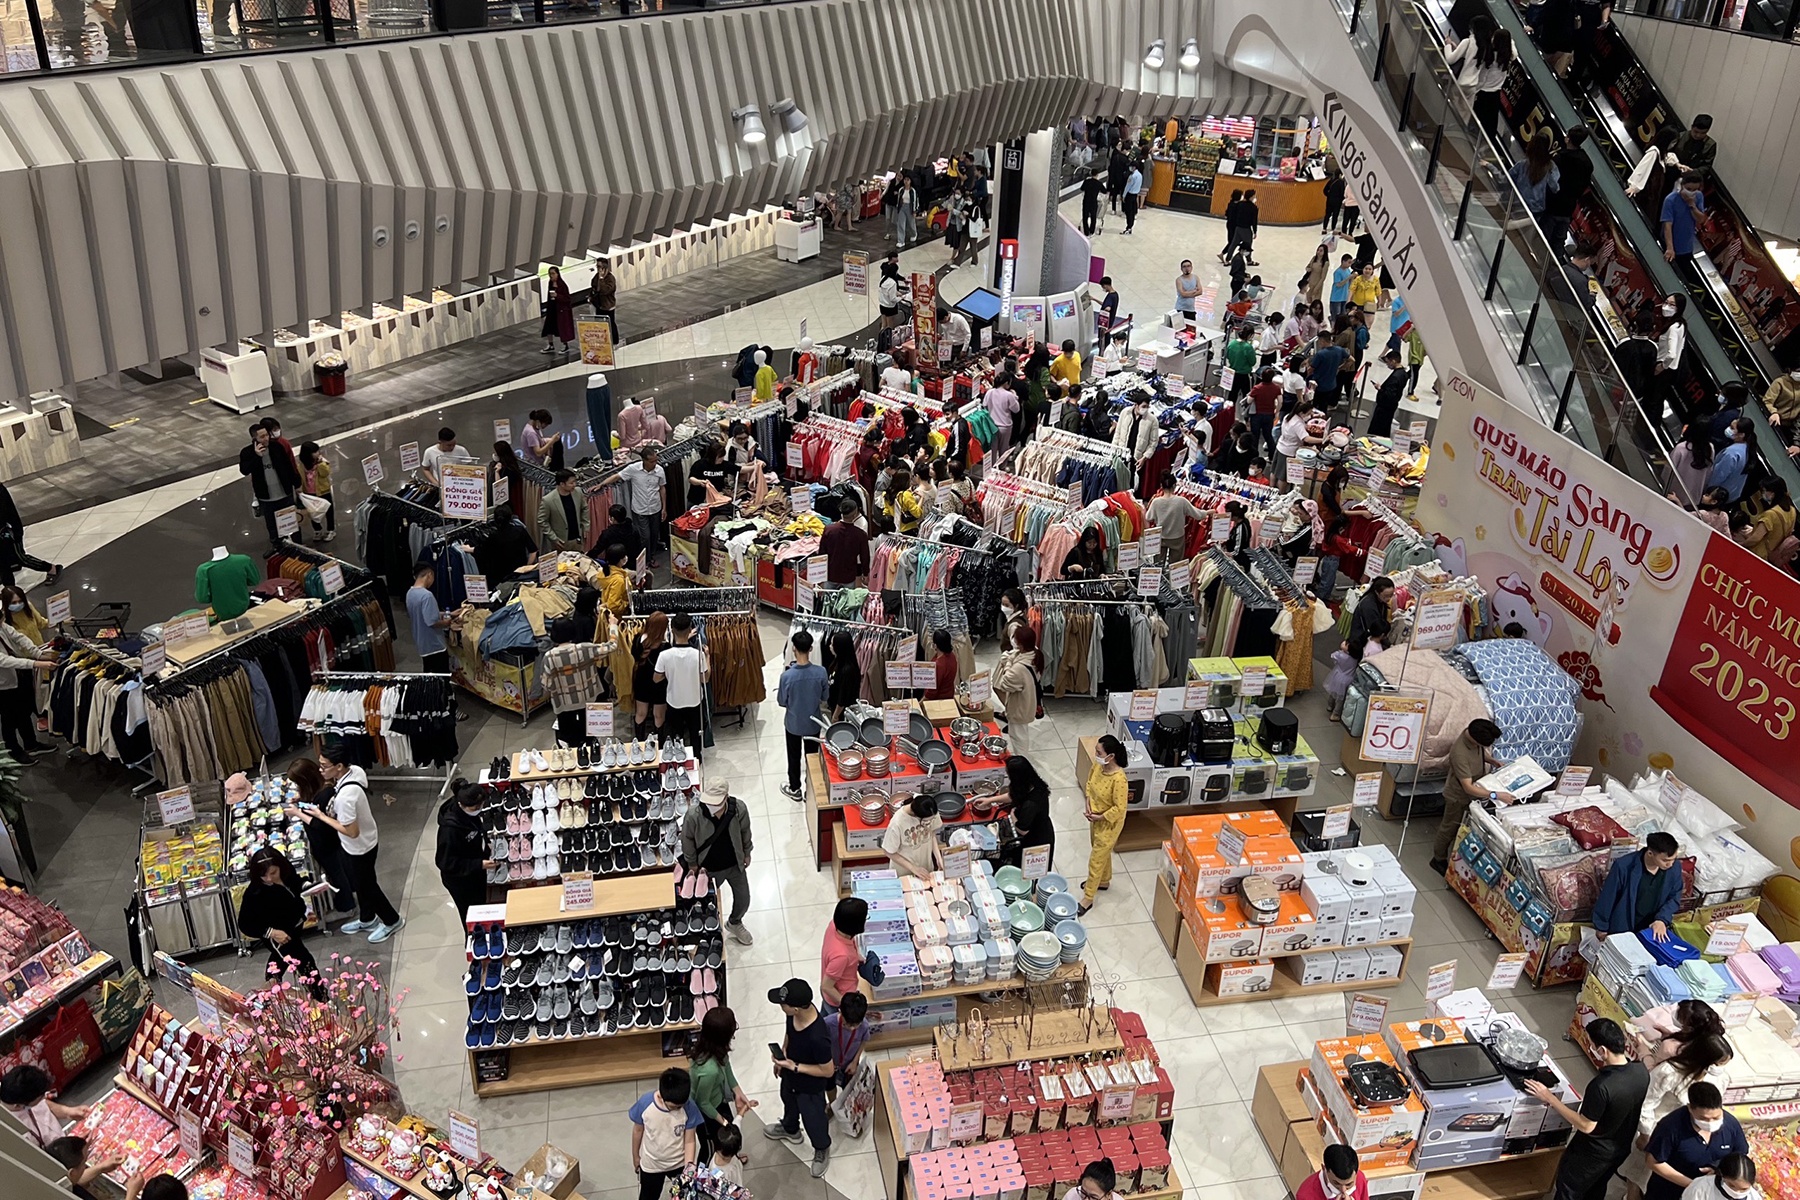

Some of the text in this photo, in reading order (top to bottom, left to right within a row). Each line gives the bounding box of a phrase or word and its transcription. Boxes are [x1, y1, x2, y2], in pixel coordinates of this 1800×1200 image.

[1334, 115, 1367, 179] Ngõ
[1393, 236, 1418, 290] Ăn
[1001, 260, 1013, 318] INFORMATION
[1473, 416, 1567, 491] QUÝ MÃO
[1480, 448, 1532, 506] TRÀN
[1529, 487, 1572, 563] Tài
[1566, 483, 1653, 566] Sang
[1700, 563, 1769, 619] CHÚC
[1703, 603, 1763, 659] NĂM
[1689, 642, 1797, 740] 2023
[1212, 932, 1242, 940] SUPOR
[1266, 927, 1295, 935] SUPOR
[1224, 968, 1253, 976] SUPOR
[1360, 1116, 1390, 1125] SUPOR
[1750, 1104, 1775, 1117] QUÝ
